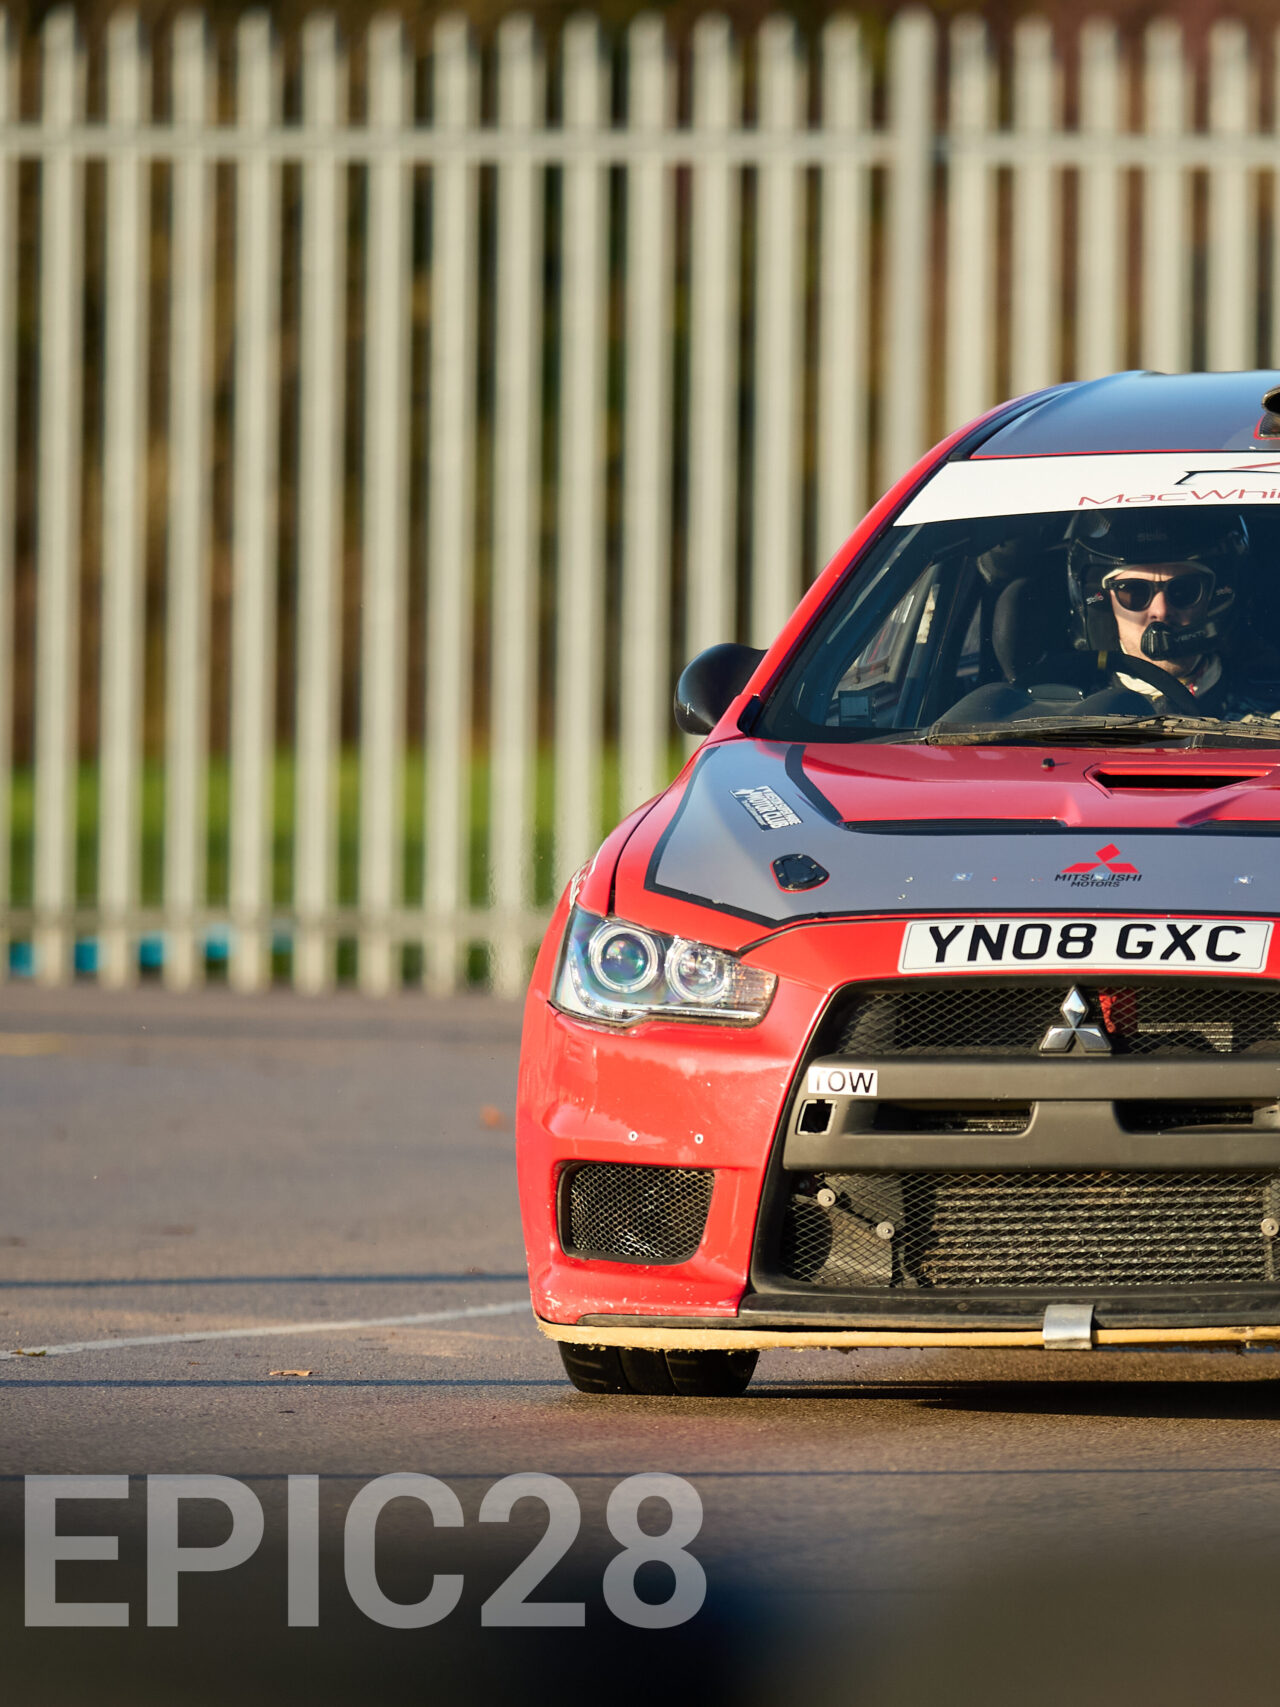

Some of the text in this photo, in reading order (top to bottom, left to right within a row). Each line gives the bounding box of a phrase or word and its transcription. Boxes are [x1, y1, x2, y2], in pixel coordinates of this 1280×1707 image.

[1054, 873, 1142, 882] MITSISHI
[928, 923, 1247, 963] YN08 GXC
